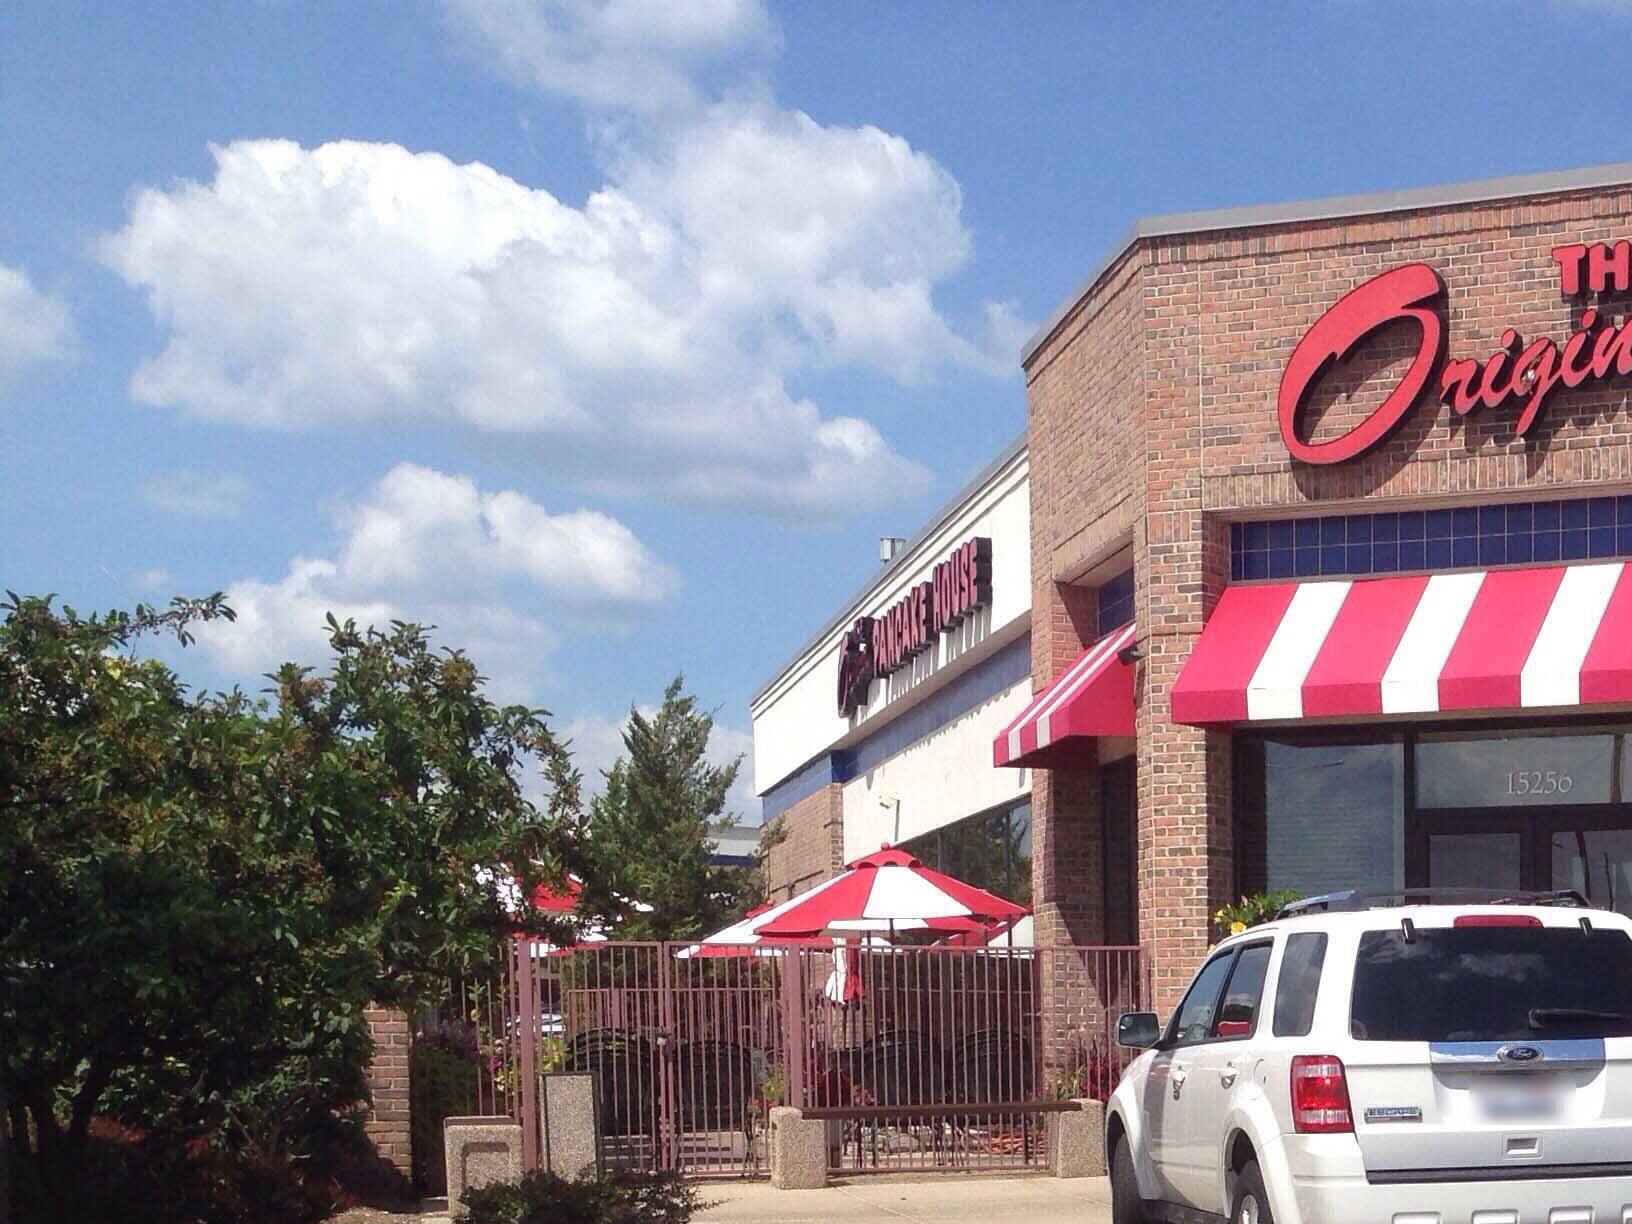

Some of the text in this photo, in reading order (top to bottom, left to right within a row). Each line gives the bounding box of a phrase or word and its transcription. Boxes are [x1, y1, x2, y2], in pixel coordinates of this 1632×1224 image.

[872, 581, 932, 679] PANCAKE
[932, 537, 990, 634] HOUSE
[1506, 771, 1573, 796] 15256
